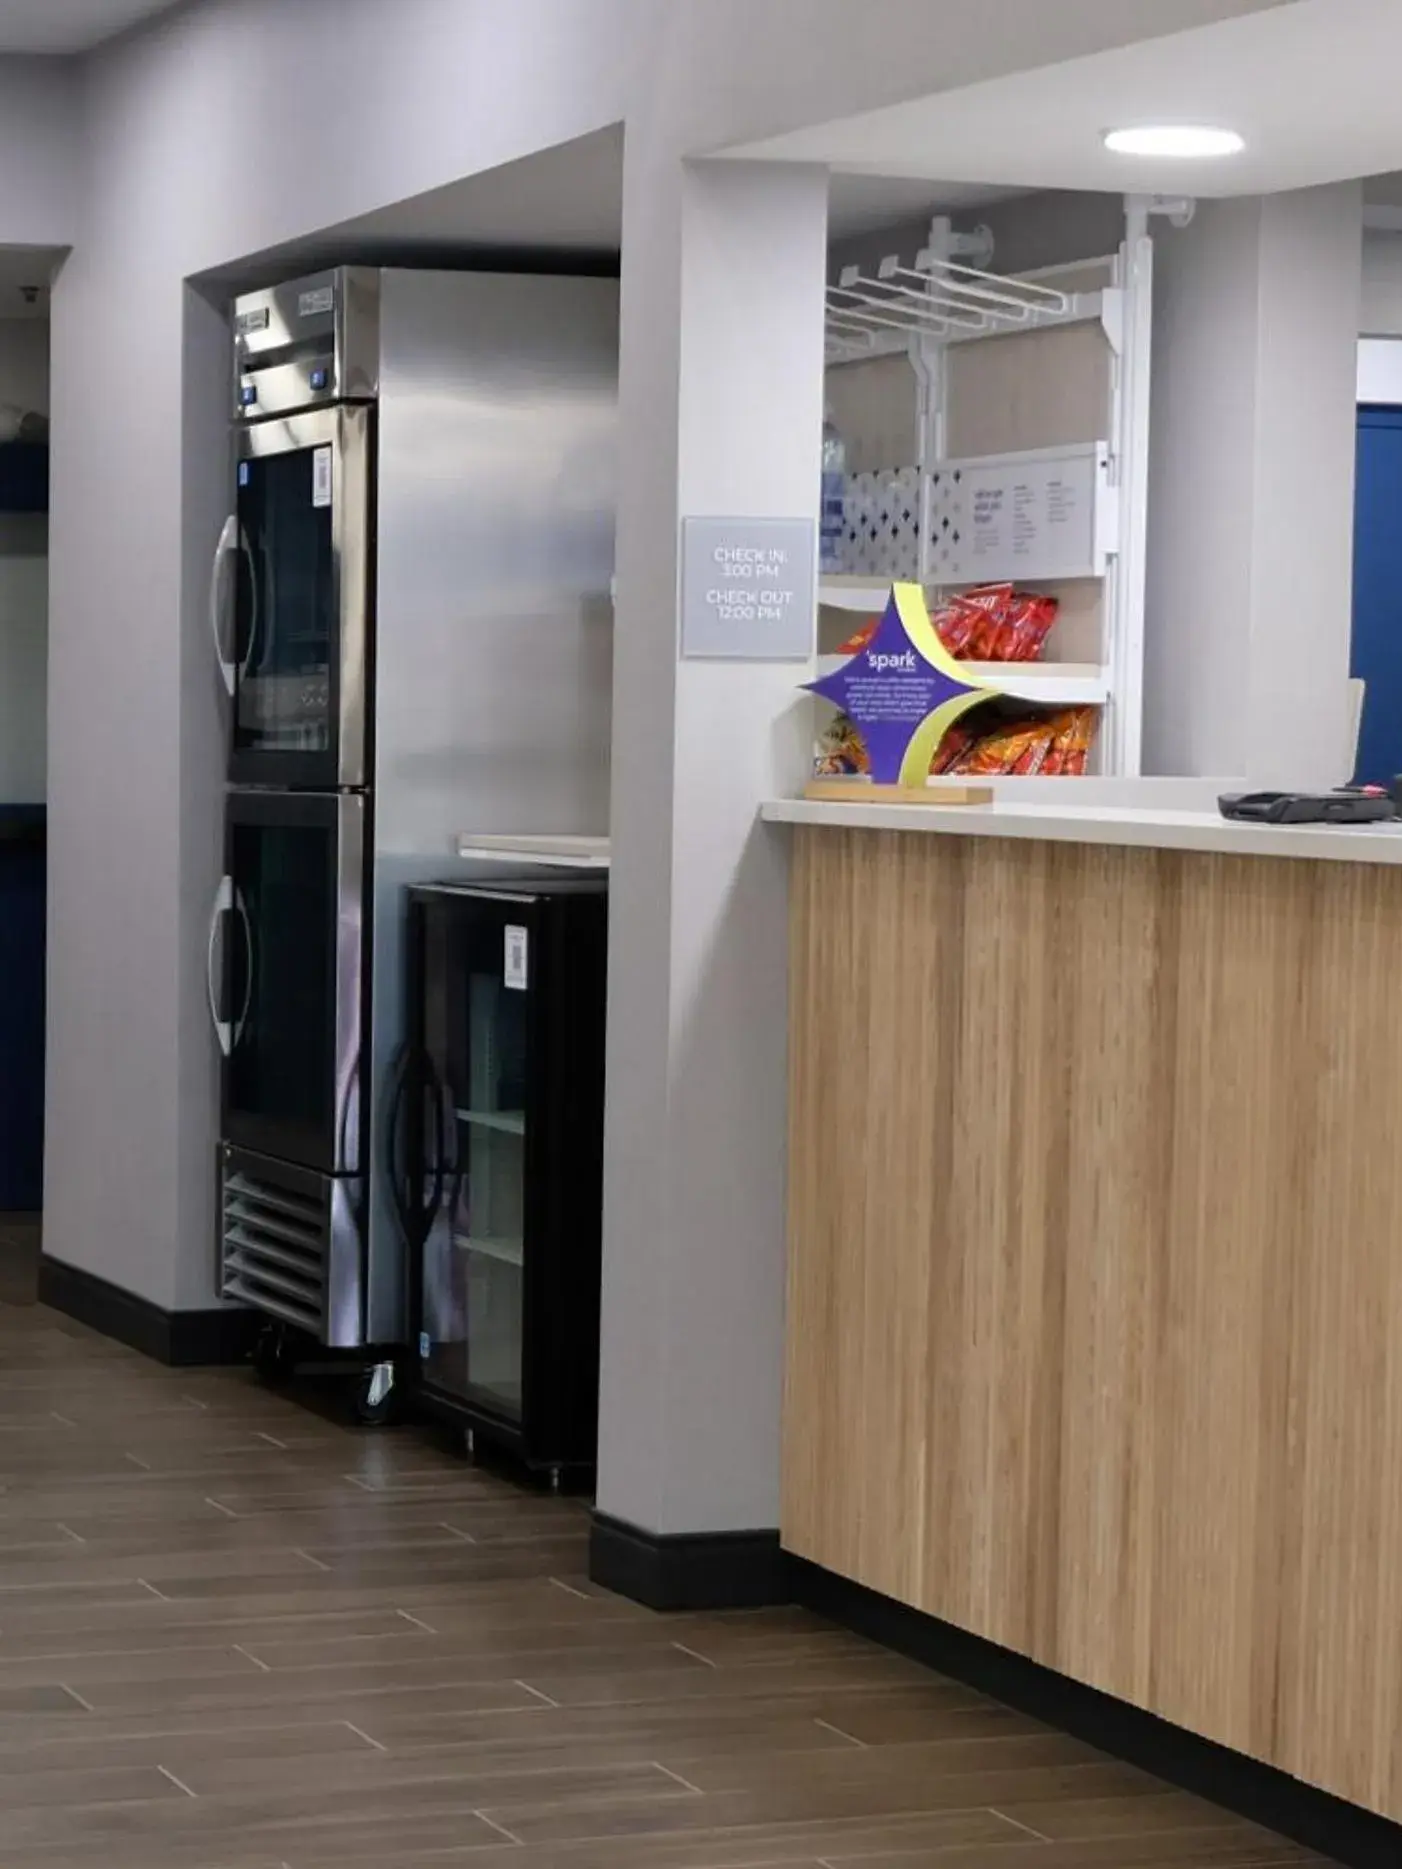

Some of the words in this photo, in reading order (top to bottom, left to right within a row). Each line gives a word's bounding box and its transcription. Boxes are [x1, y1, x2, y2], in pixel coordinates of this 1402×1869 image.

[714, 547, 765, 563] CHECK
[756, 563, 779, 579] PM
[706, 589, 758, 605] CHECK
[761, 589, 793, 605] OUT
[757, 605, 781, 621] PM
